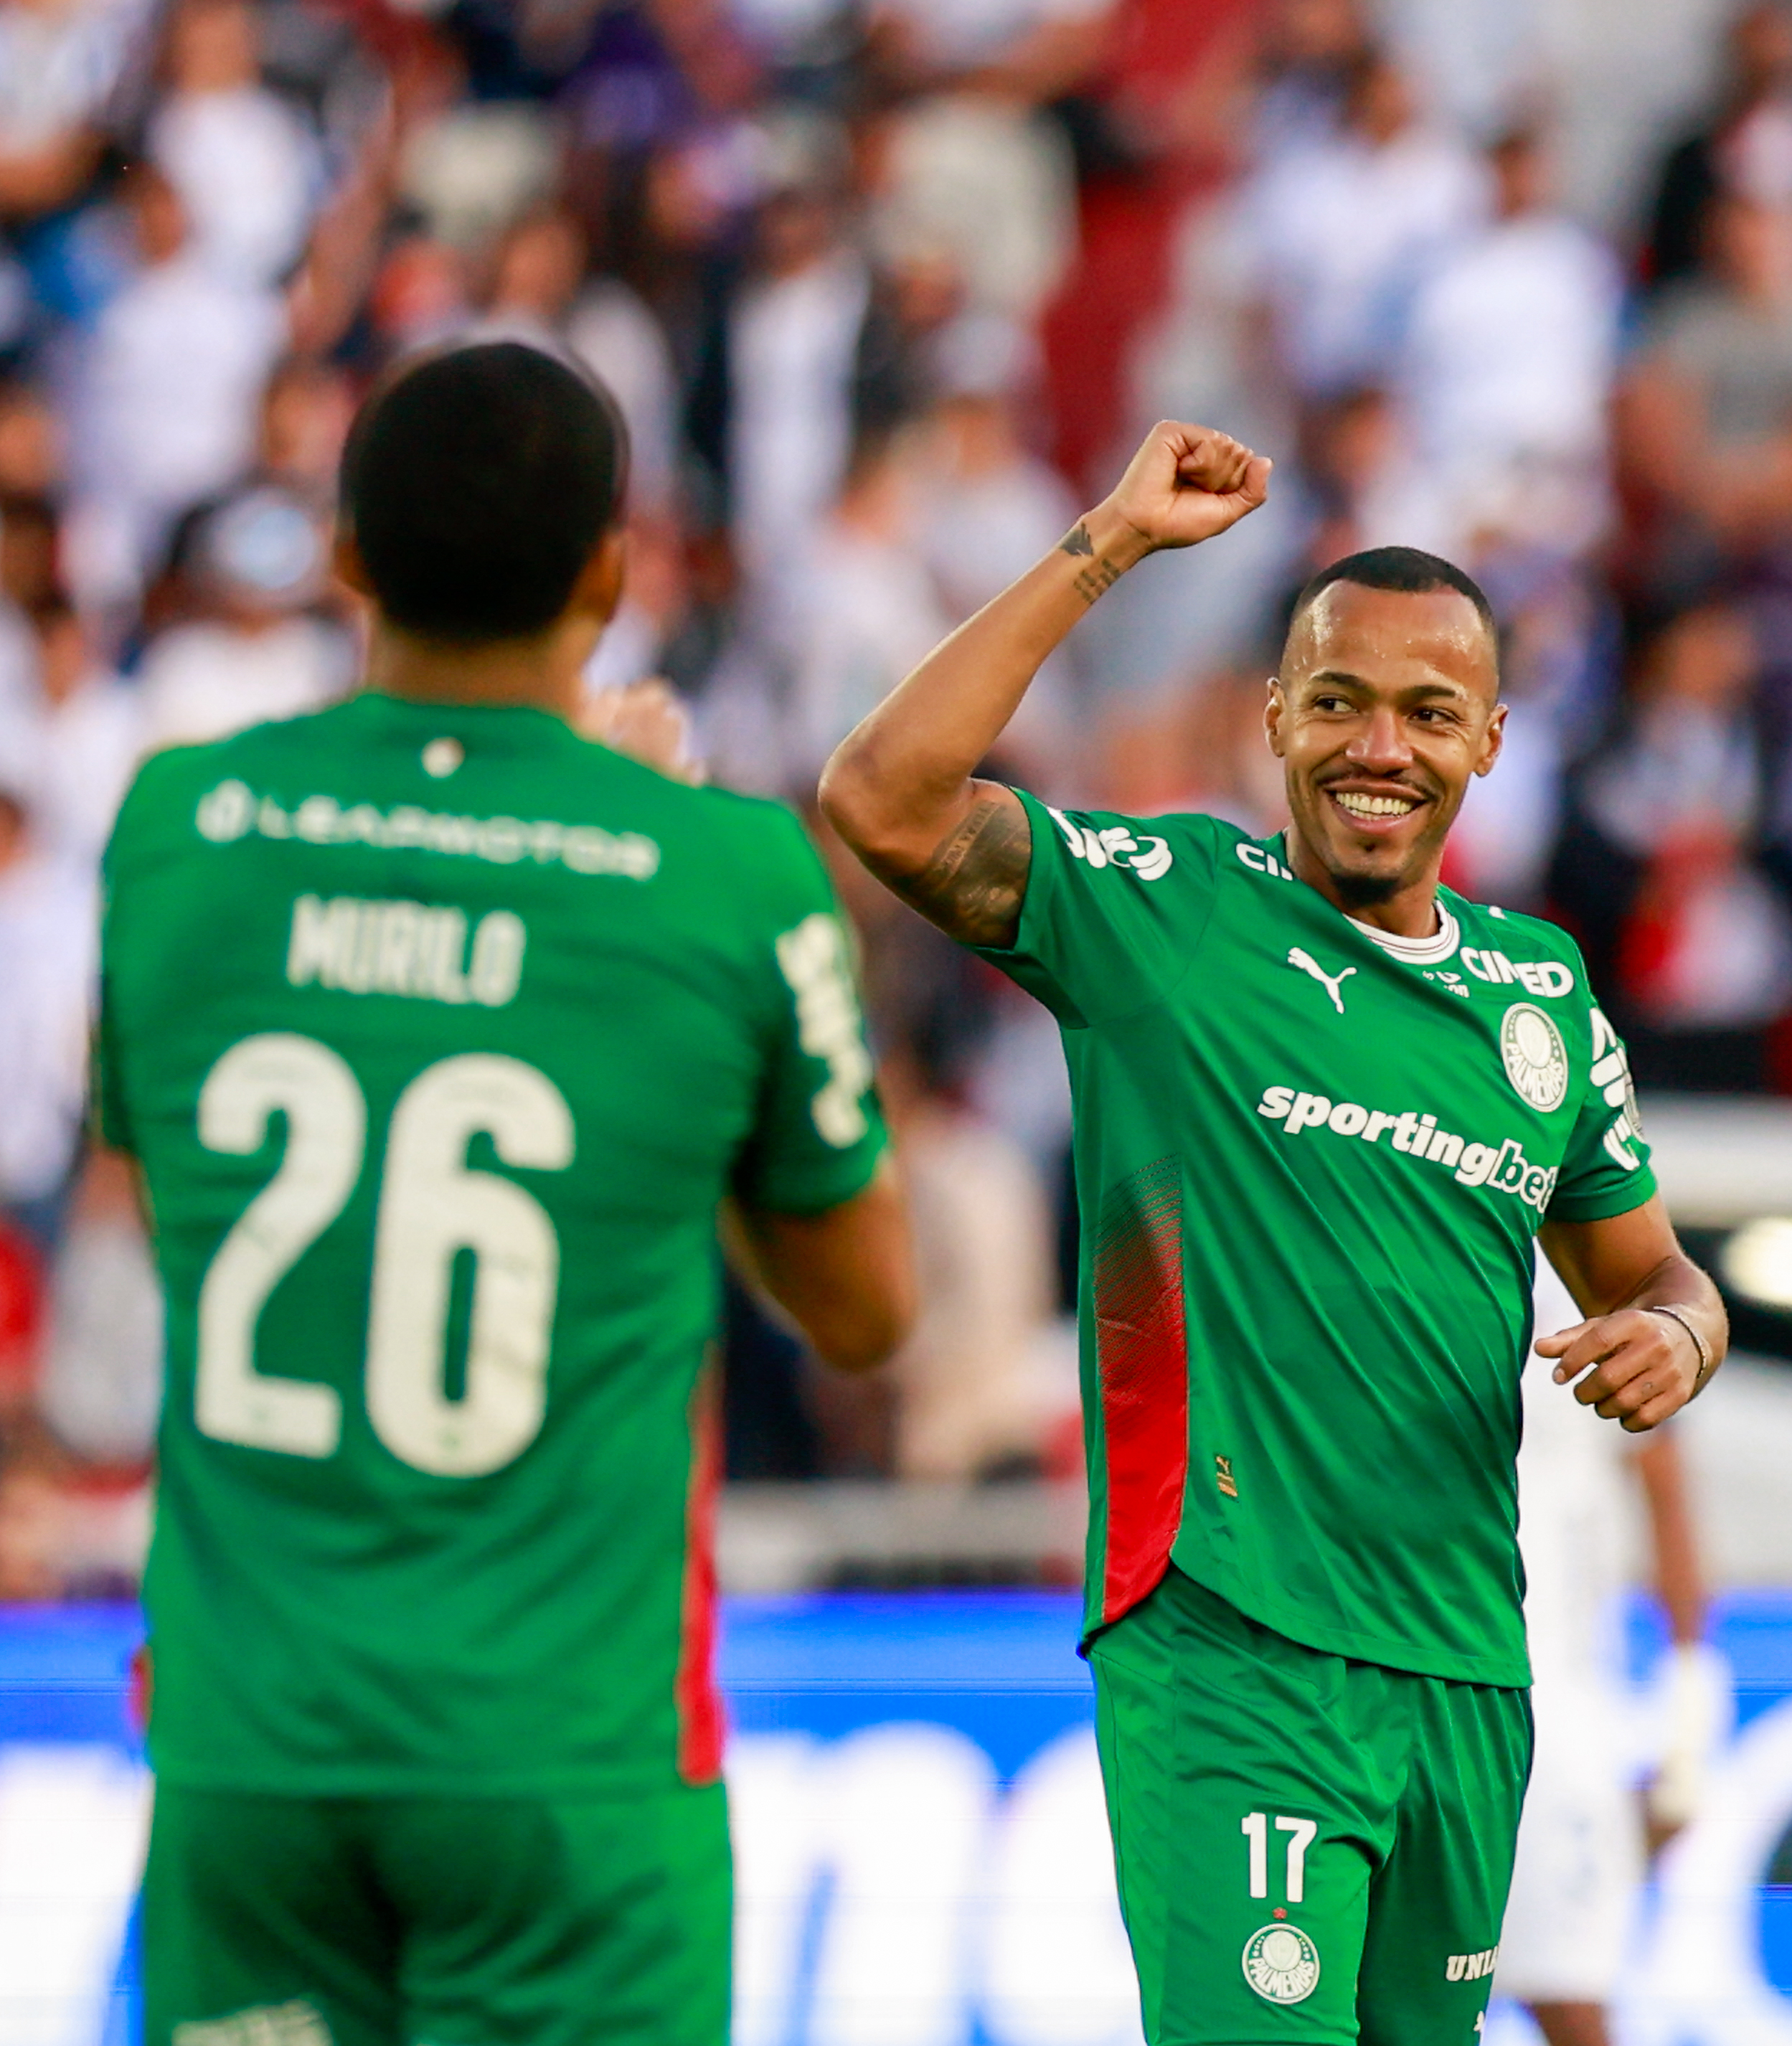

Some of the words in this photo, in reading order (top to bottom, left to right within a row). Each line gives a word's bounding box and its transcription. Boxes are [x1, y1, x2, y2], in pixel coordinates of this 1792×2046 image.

[286, 892, 527, 1007] MURILO
[1507, 1042, 1564, 1106] PALMEIRAS
[1257, 1085, 1558, 1214] sportingbet
[195, 1031, 576, 1479] 26
[1241, 1811, 1317, 1903] 17
[1248, 1957, 1316, 1998] PALMEIRAS
